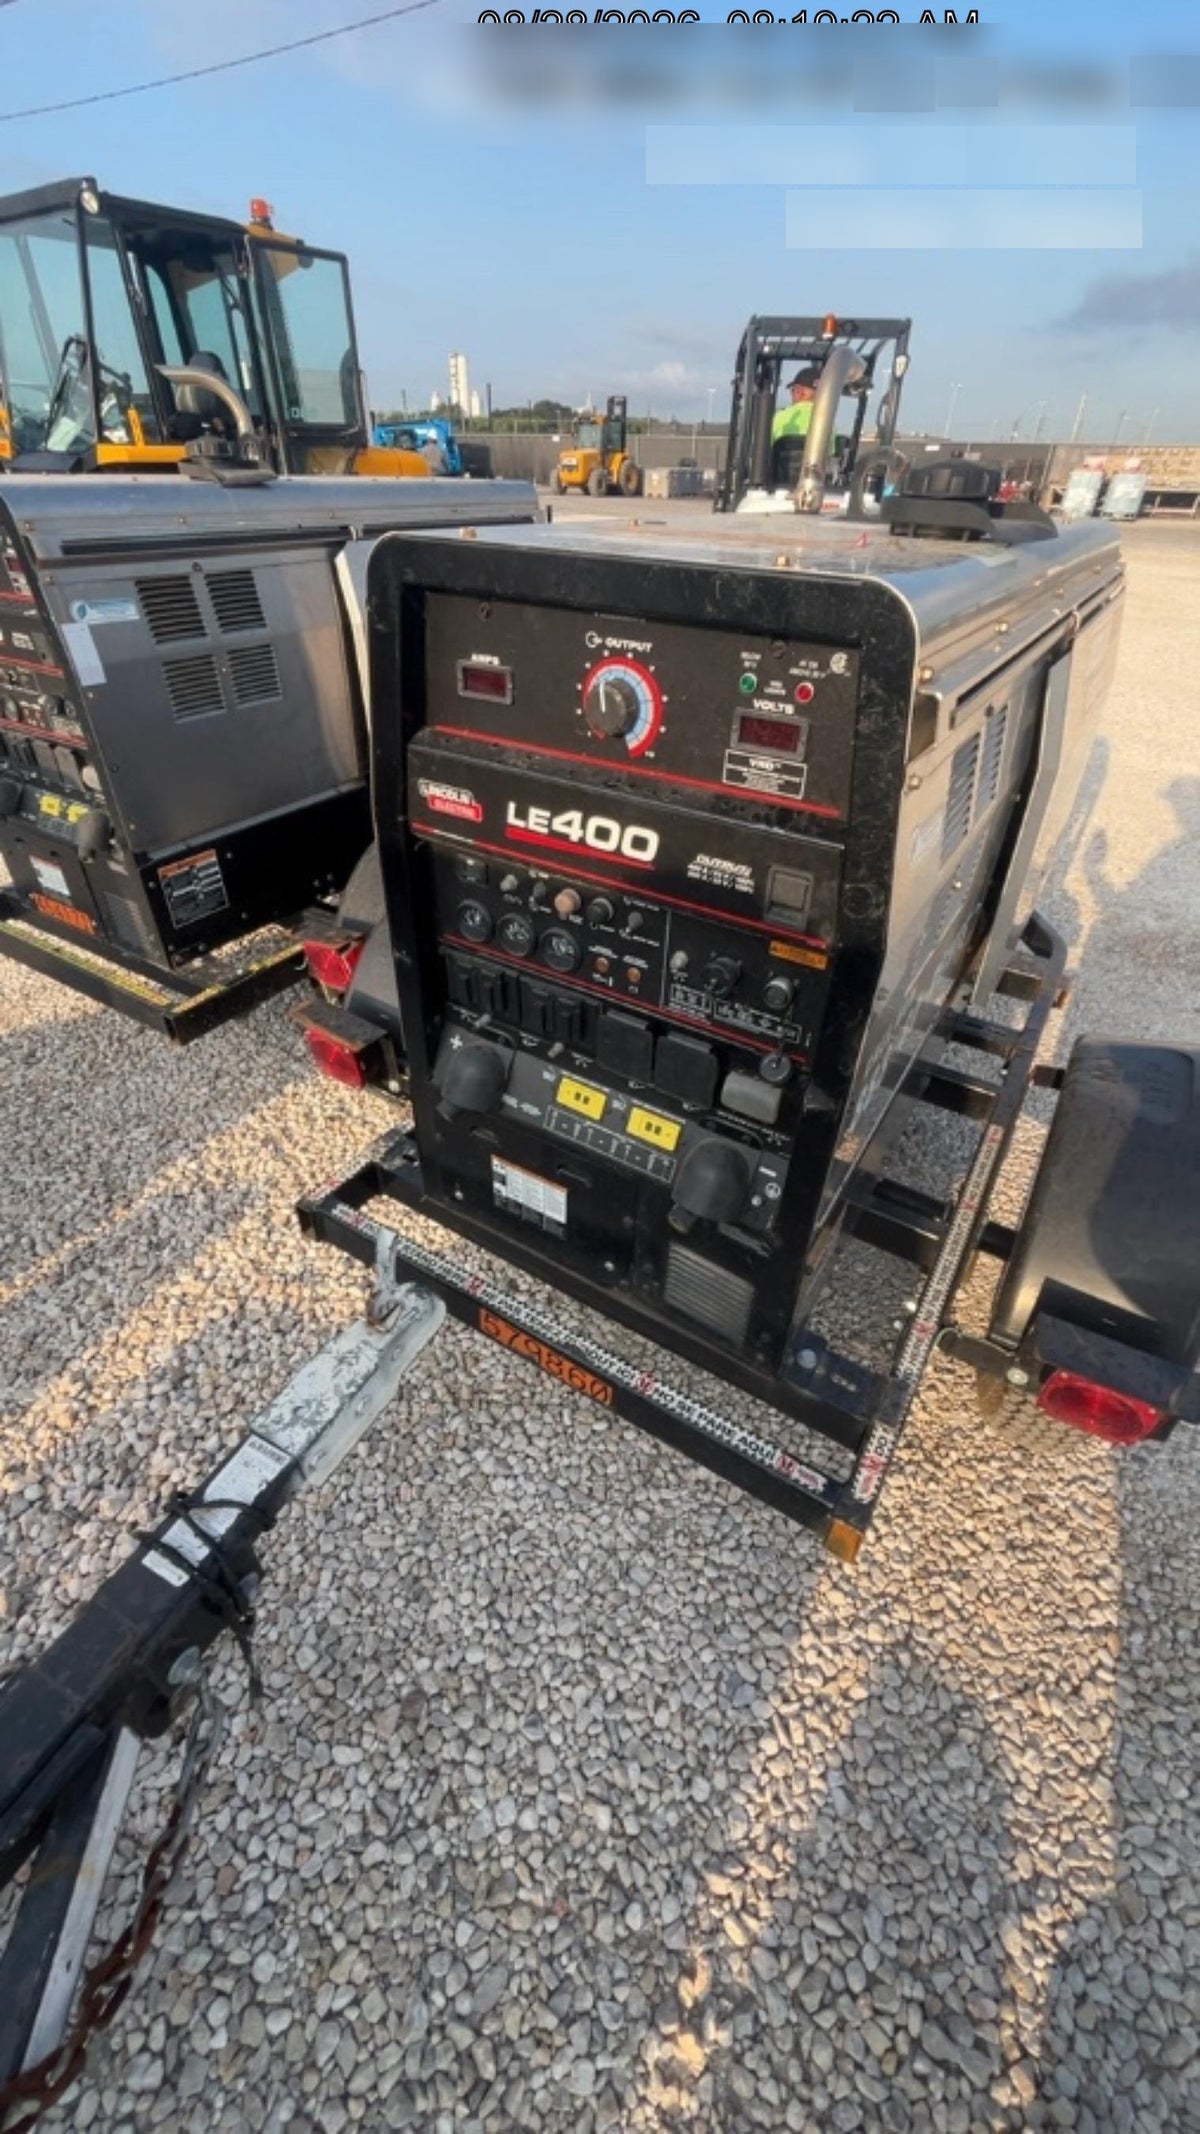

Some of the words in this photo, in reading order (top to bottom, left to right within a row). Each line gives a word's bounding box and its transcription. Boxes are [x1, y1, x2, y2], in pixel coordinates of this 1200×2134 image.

[605, 637, 653, 652] OUTPUT
[752, 698, 795, 715] VOLTS
[506, 801, 659, 862] LE400
[482, 1311, 609, 1402] 579860
